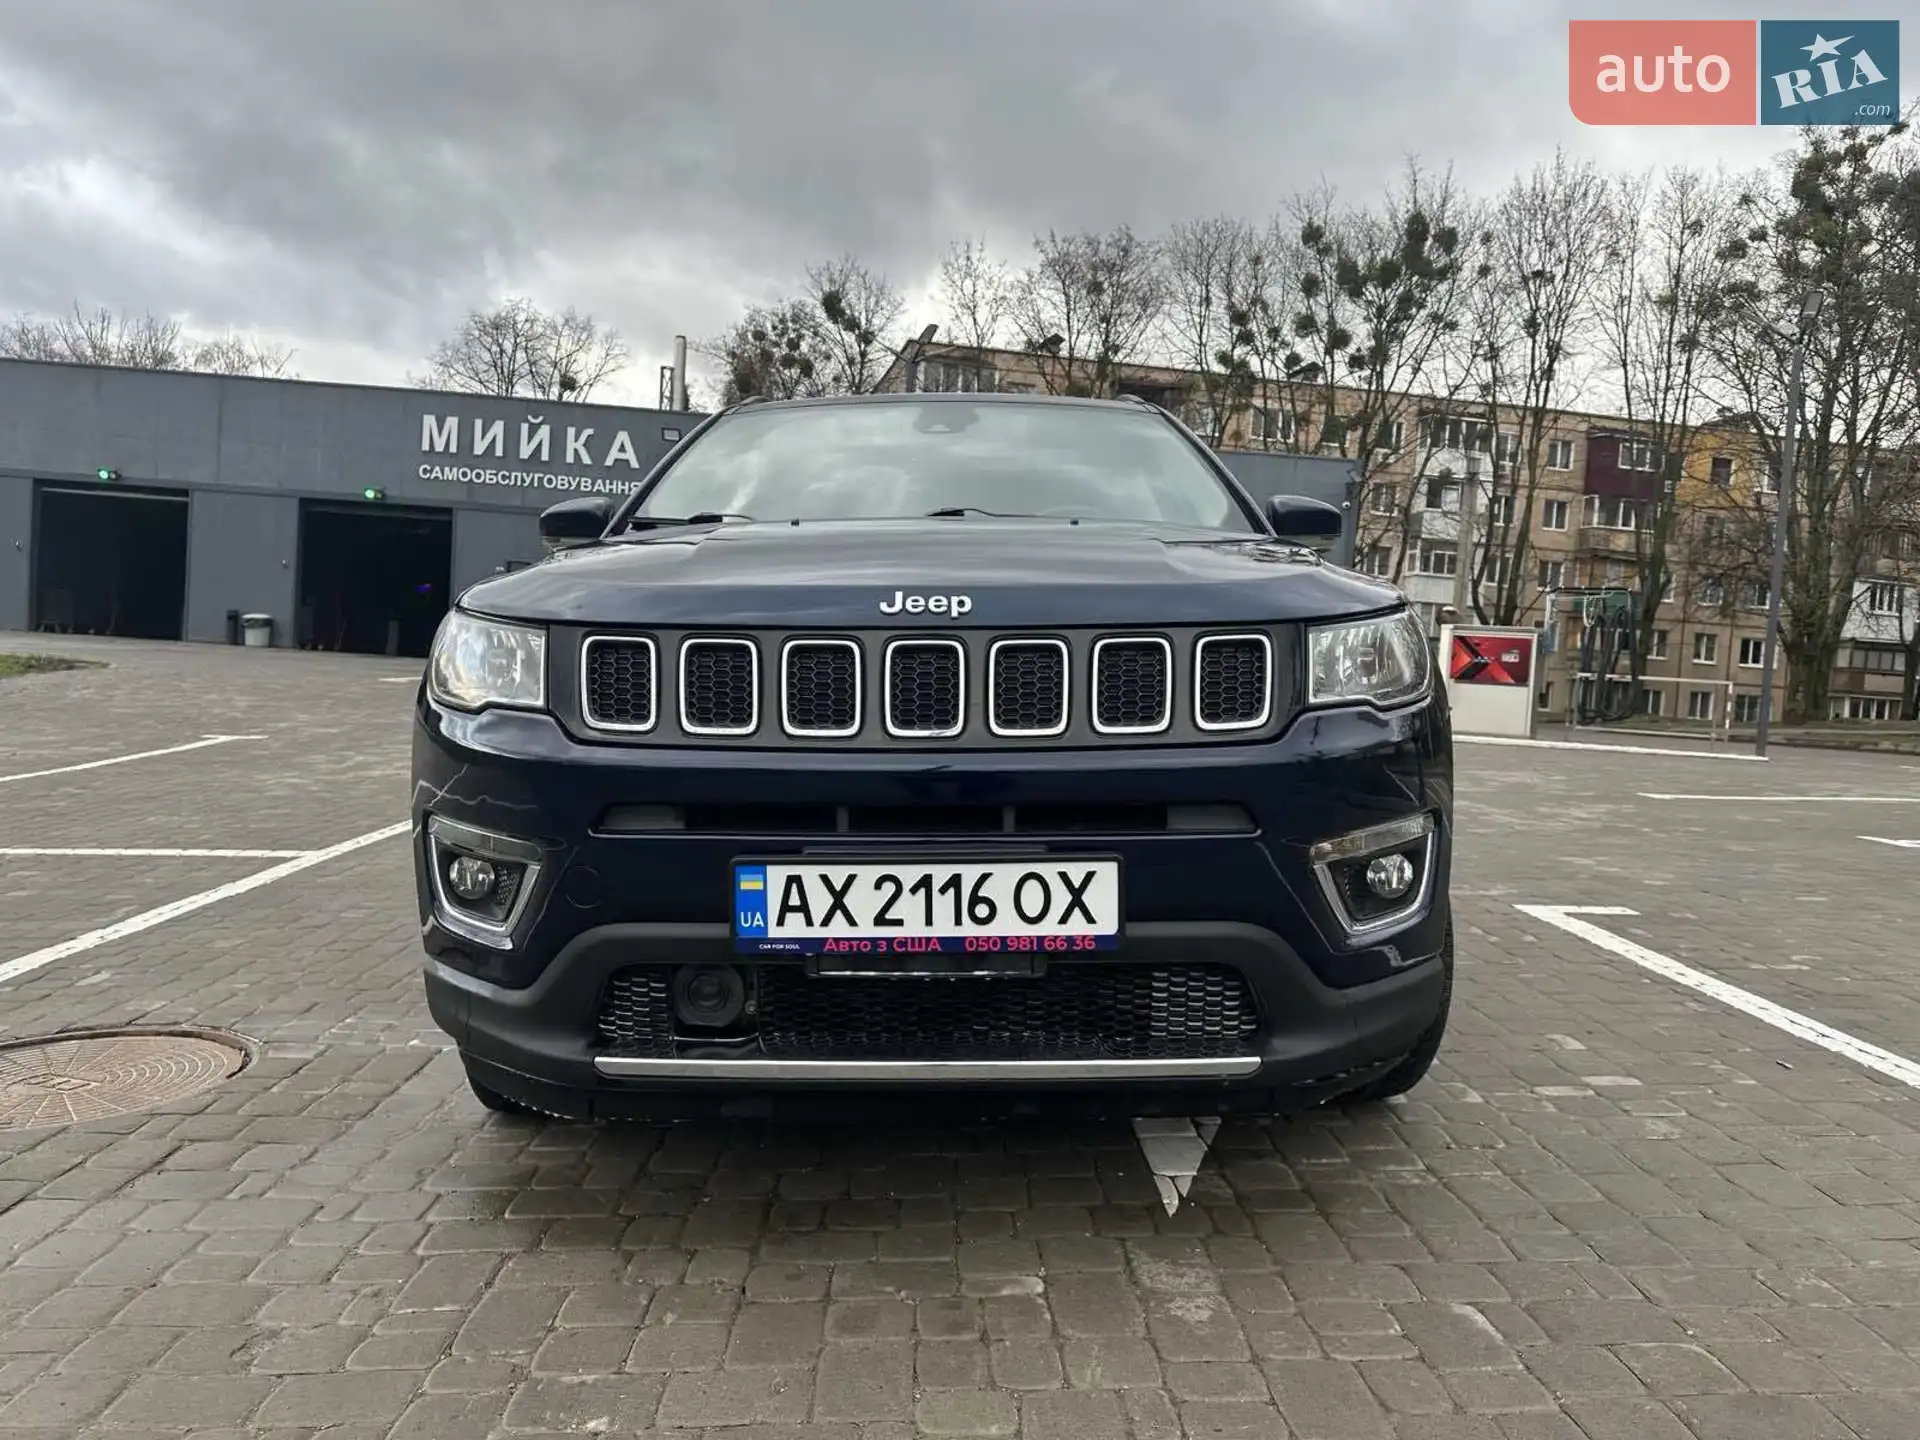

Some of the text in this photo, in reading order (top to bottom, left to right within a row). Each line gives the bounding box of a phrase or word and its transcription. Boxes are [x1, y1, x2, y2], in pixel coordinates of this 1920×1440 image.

[420, 414, 640, 469] МИЙКА
[879, 591, 972, 617] Jeep
[776, 871, 1097, 927] AX 2116 OX
[740, 912, 764, 928] UA
[823, 938, 942, 953] Авто з США
[965, 935, 1096, 951] 050 981 66 36
